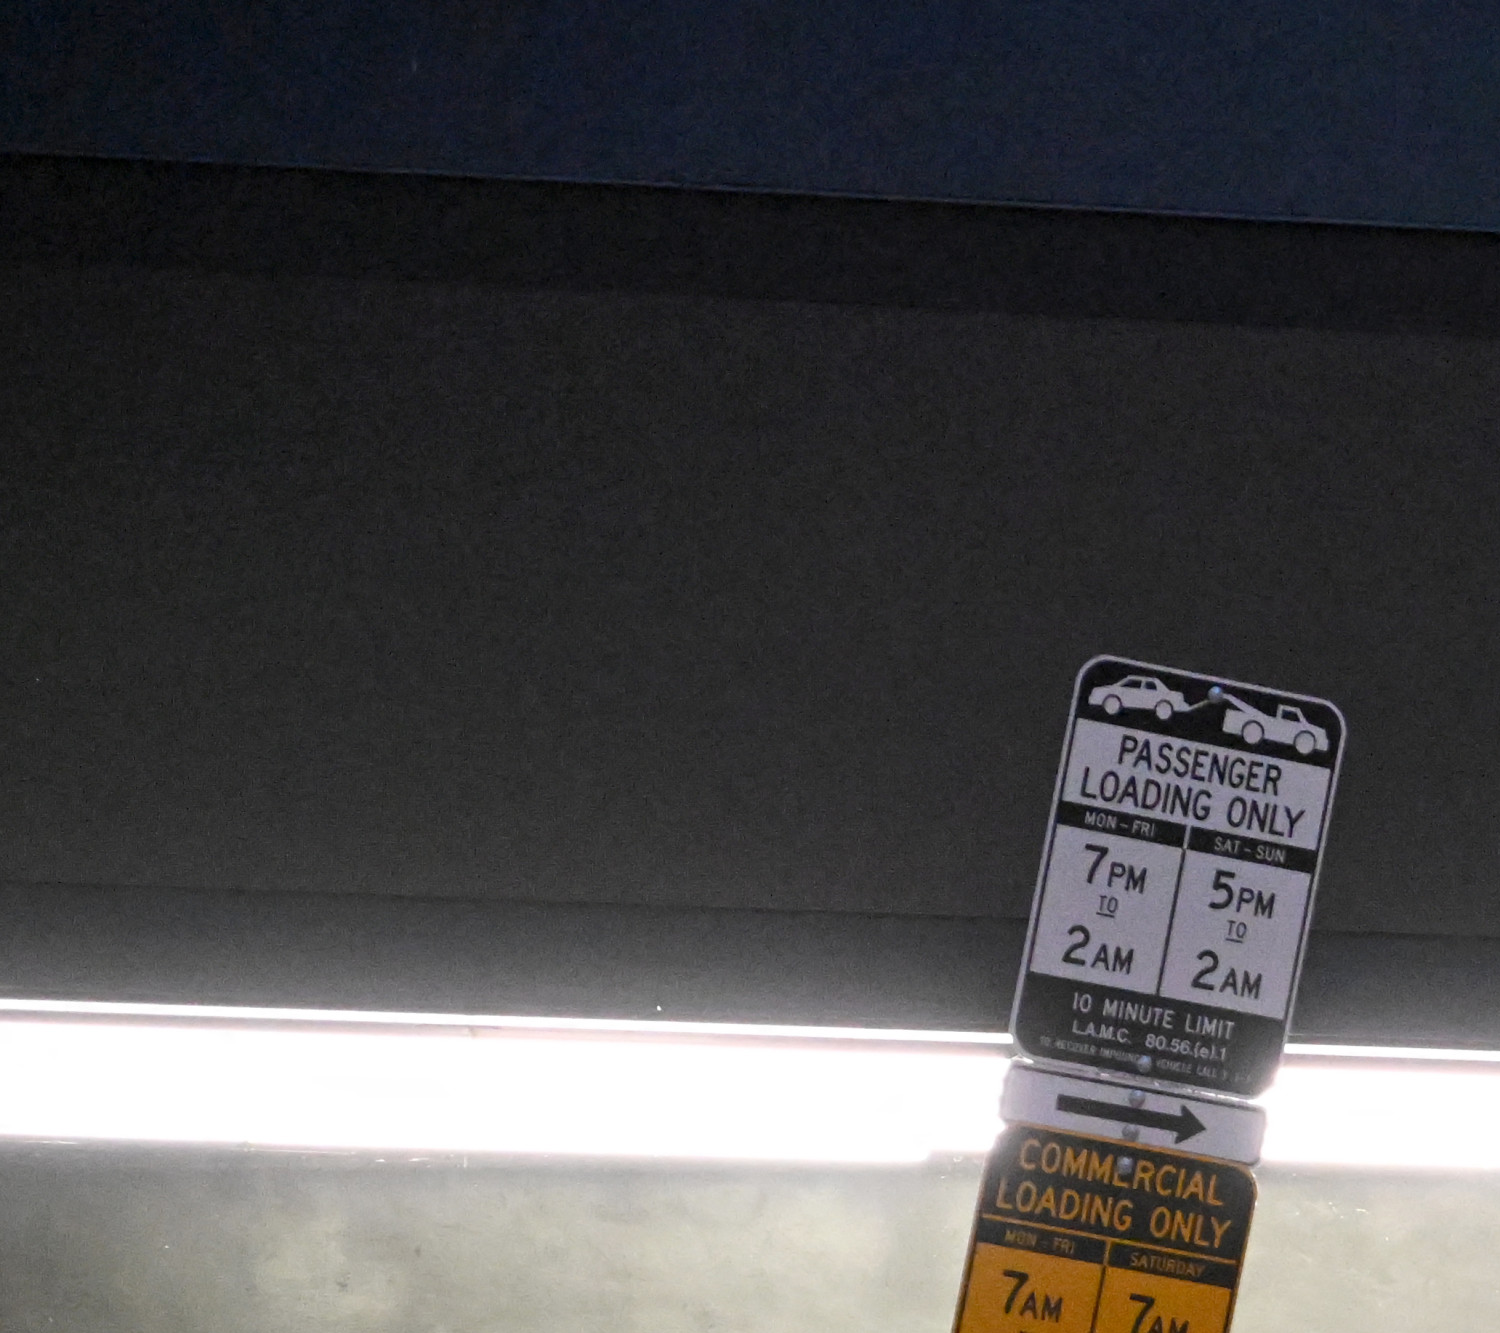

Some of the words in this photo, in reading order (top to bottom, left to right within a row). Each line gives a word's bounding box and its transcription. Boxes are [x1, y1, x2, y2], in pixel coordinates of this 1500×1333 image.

[1117, 734, 1282, 797] PASSENGER
[1080, 766, 1213, 822] LOADING
[1226, 795, 1306, 839] ONLY
[1084, 843, 1148, 894] 7PM
[1099, 895, 1119, 914] TO
[1208, 869, 1276, 919] 5PM
[1061, 924, 1135, 975] 2AM
[1227, 919, 1248, 939] TO
[1190, 949, 1263, 999] 2AM
[1072, 992, 1092, 1013] 10
[1102, 998, 1175, 1029] MINUTE
[1185, 1013, 1235, 1040] LIMIT
[995, 1174, 1134, 1231] LOADING
[1149, 1206, 1232, 1249] ONLY
[1130, 1252, 1205, 1277] SATURDAY
[1002, 1269, 1063, 1324] 7AM
